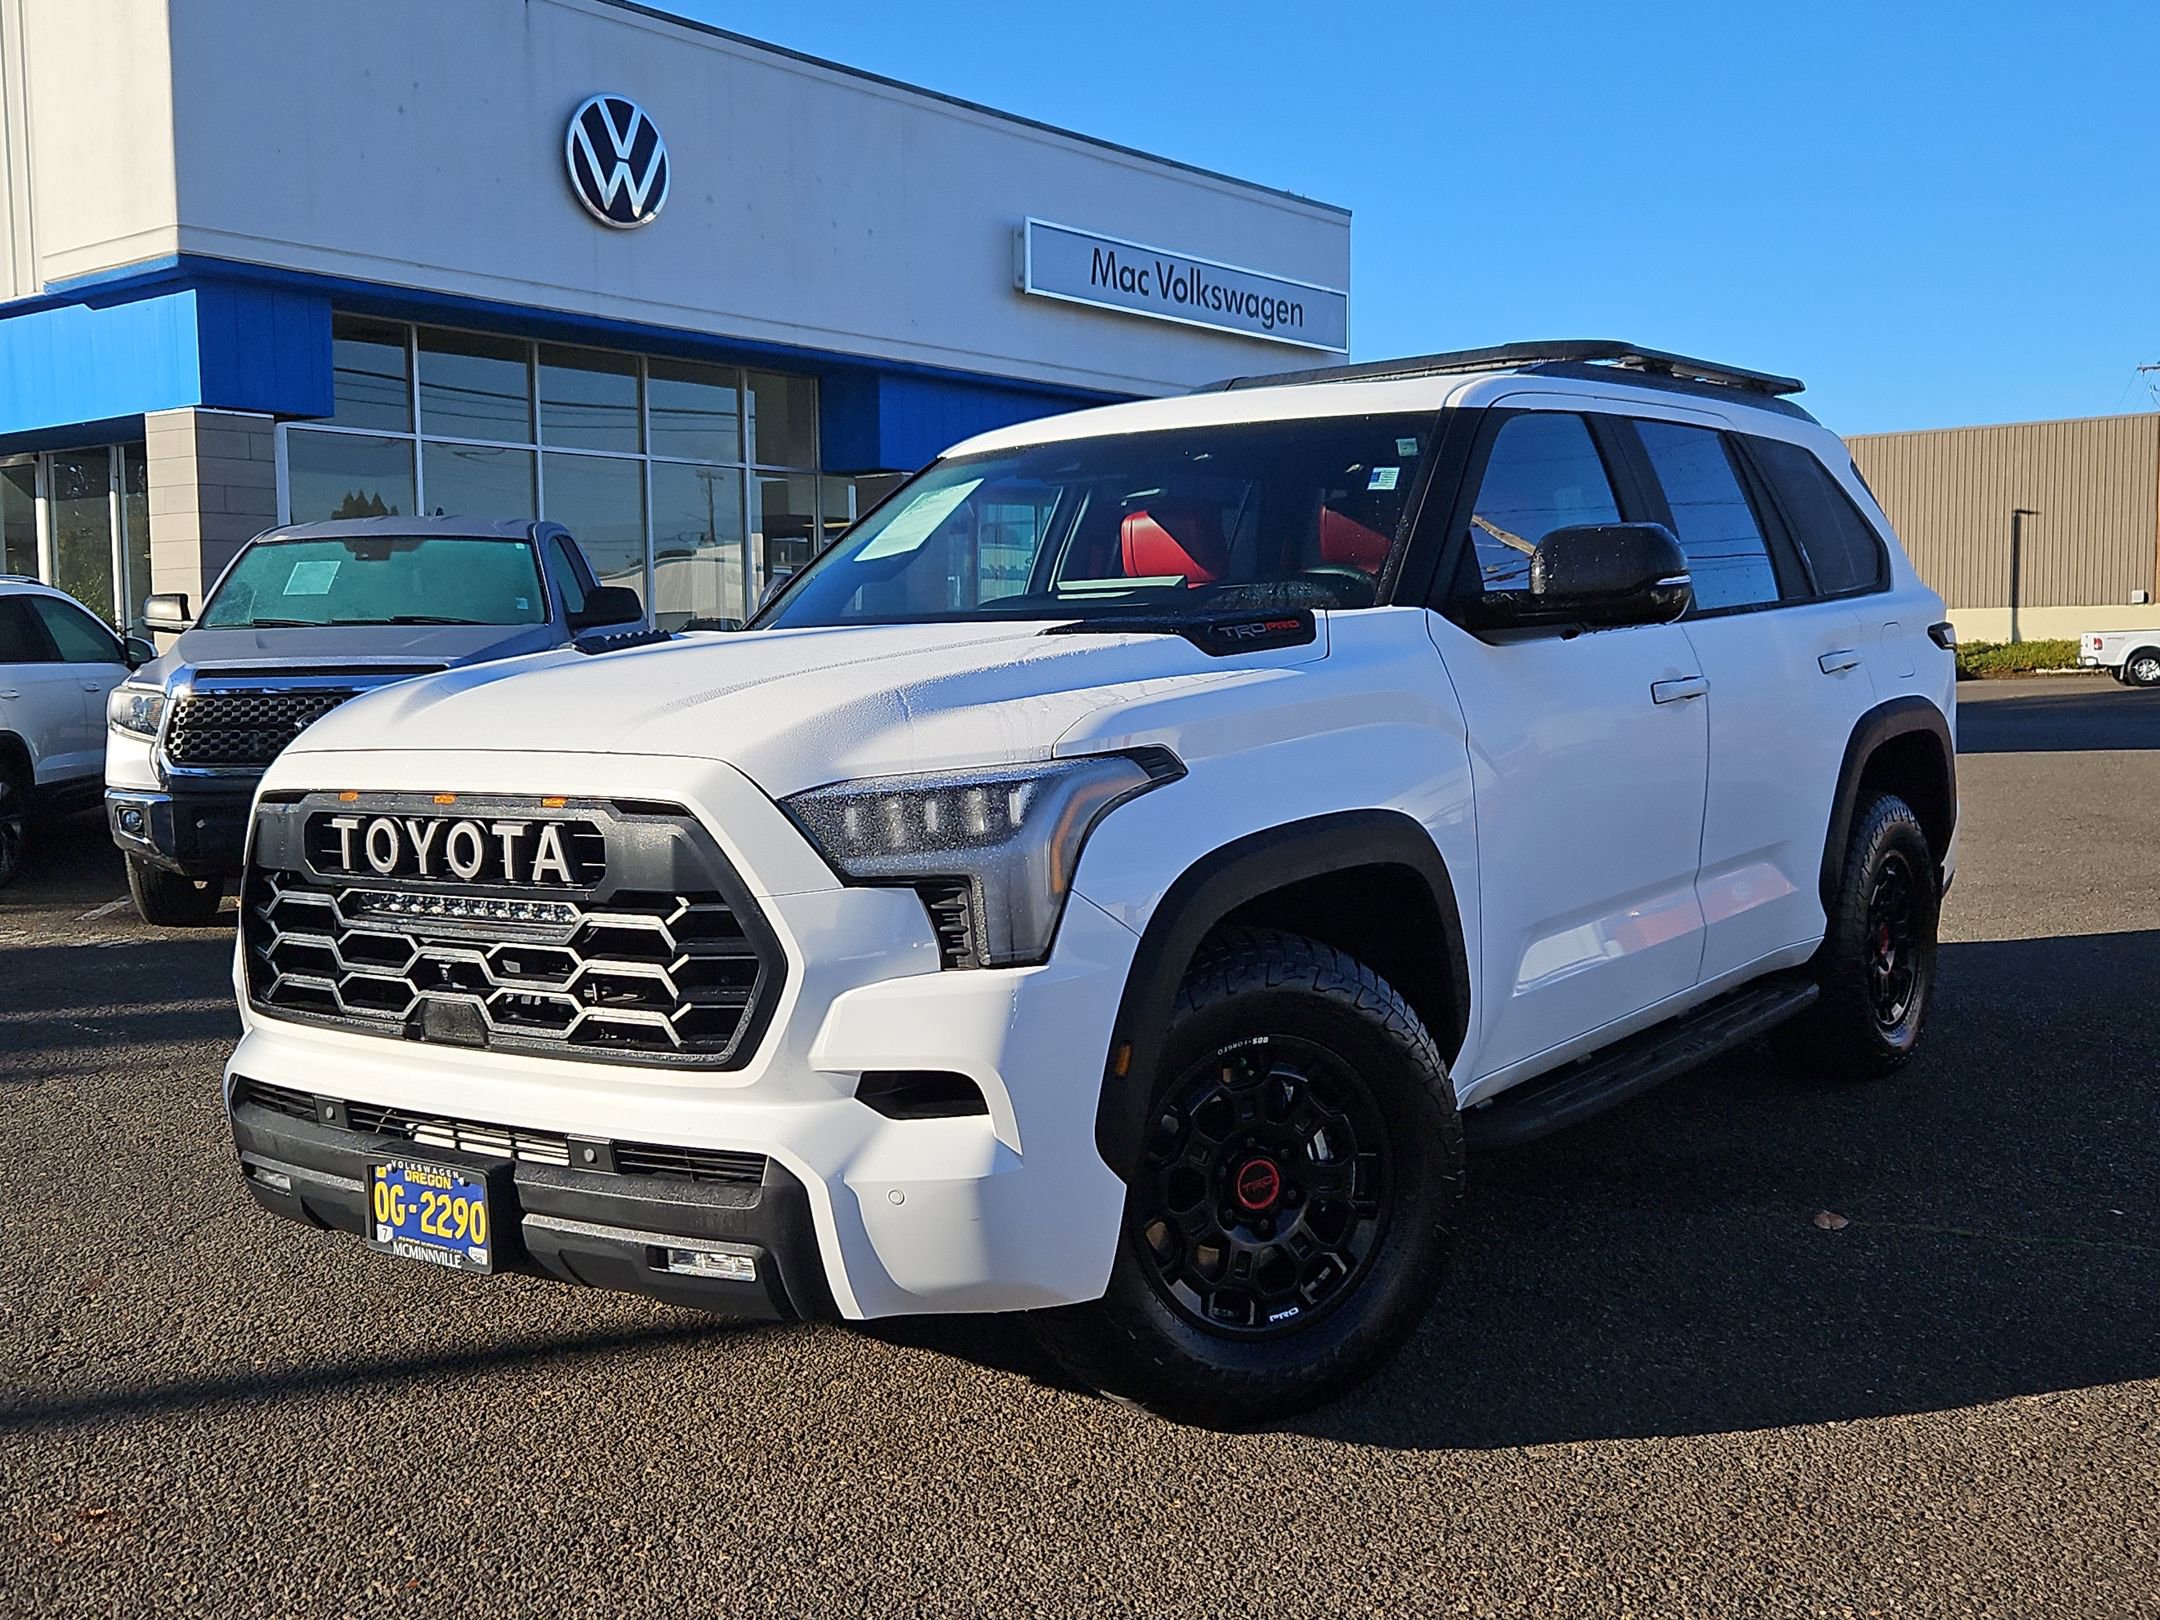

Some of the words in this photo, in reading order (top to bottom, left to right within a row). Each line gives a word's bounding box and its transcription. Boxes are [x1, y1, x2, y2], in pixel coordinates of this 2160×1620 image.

[568, 95, 669, 226] VW
[1090, 247, 1150, 297] Mac
[1155, 260, 1304, 331] Volkswagen
[331, 815, 574, 882] TOYOTA
[391, 1159, 460, 1178] VOLKSWAGEN
[404, 1169, 454, 1190] OREGON
[393, 1241, 462, 1269] MCMINNVILLE
[1269, 1306, 1300, 1323] PRO
